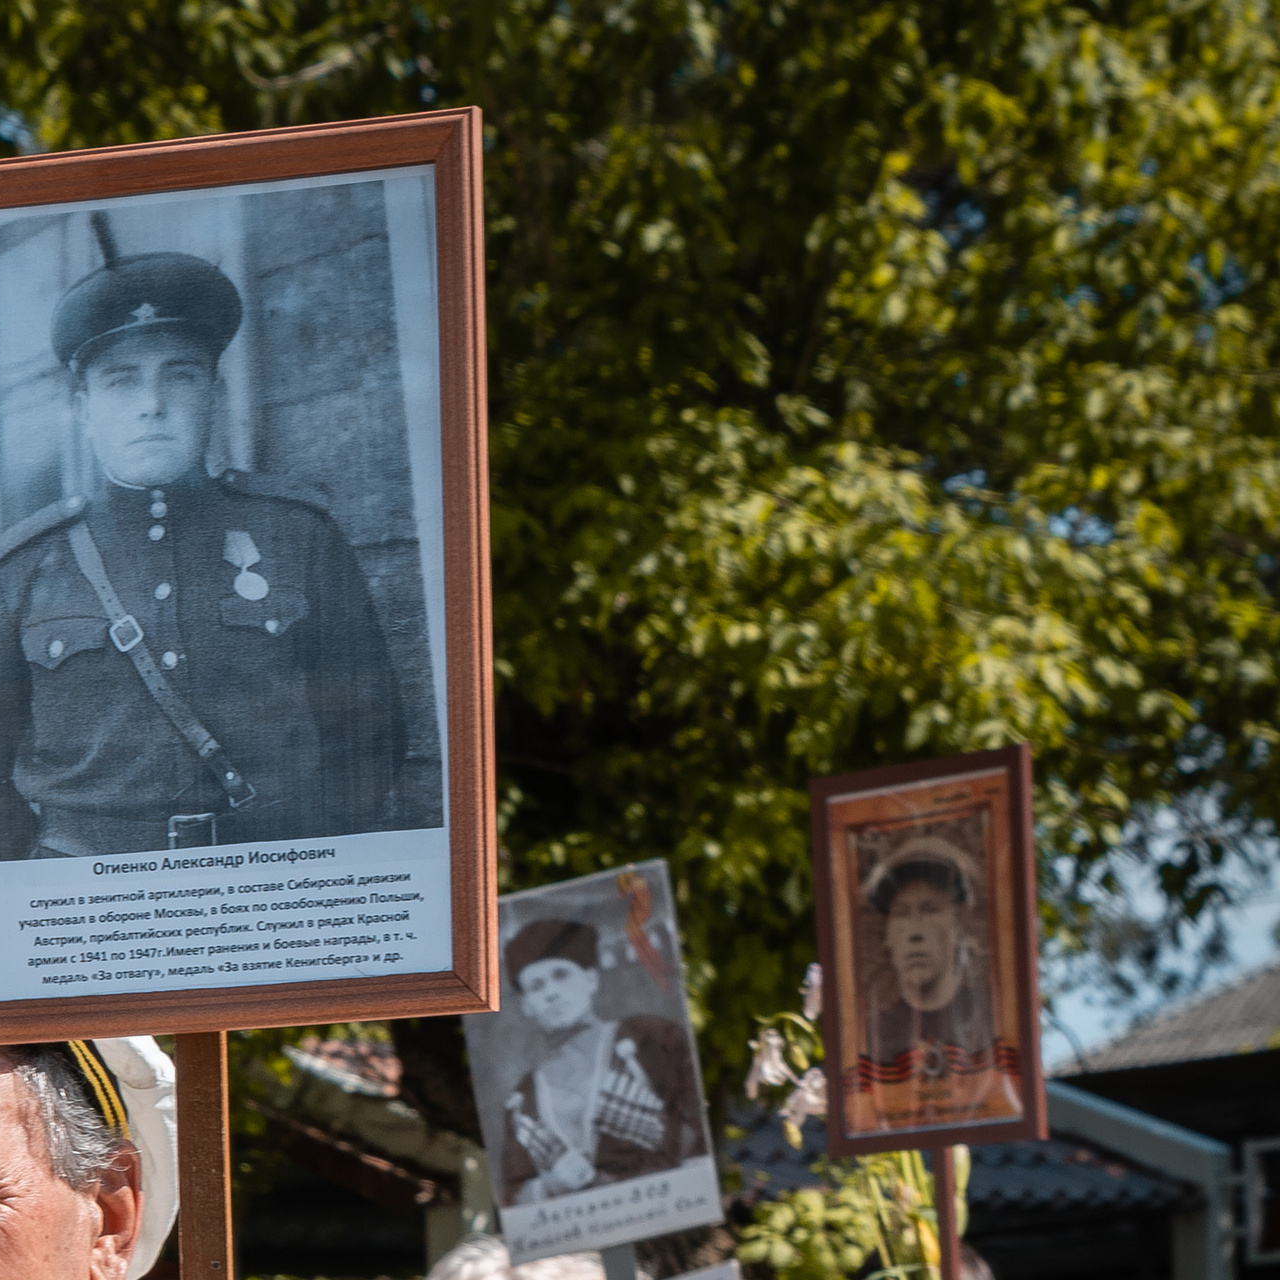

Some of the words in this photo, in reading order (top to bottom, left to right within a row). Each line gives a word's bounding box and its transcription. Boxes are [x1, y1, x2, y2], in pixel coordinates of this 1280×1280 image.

[93, 861, 158, 876] Огиенко
[161, 856, 244, 870] Александр
[248, 849, 335, 864] Иосифович
[29, 897, 76, 910] служил
[77, 896, 86, 905] в
[87, 889, 146, 905] зенитной
[147, 887, 225, 902] артиллерии,
[227, 885, 236, 895] в
[237, 882, 285, 896] составе
[286, 874, 356, 892] Сибирской
[356, 873, 411, 888] дивизии
[18, 915, 87, 931] участвовал
[88, 915, 97, 924] в
[98, 910, 152, 925] обороне
[154, 907, 209, 919] Москвы,
[209, 906, 219, 916] в
[219, 902, 250, 915] боях
[252, 903, 269, 912] по
[270, 896, 367, 911] освобождению
[369, 892, 425, 904] Польши,
[33, 935, 88, 948] Австрии,
[89, 927, 183, 945] прибалтийских
[185, 922, 255, 939] республик.
[256, 920, 305, 933] Служил
[306, 919, 315, 928] в
[317, 916, 355, 930] рядах
[357, 910, 410, 927] Красной
[27, 956, 68, 969] армии
[69, 955, 78, 964] с
[79, 951, 109, 965] 1941
[110, 952, 127, 961] по
[207, 942, 260, 957] ранения
[262, 942, 271, 950] и
[273, 938, 321, 950] боевые
[323, 934, 381, 948] награды,
[383, 933, 392, 942] в
[42, 973, 89, 986] медаль
[90, 967, 113, 981] «За
[114, 969, 165, 980] отвагу»,
[167, 965, 216, 977] медаль
[216, 961, 240, 973] «За
[241, 960, 283, 972] взятие
[285, 953, 370, 968] Кенигсберга»
[372, 954, 381, 962] и
